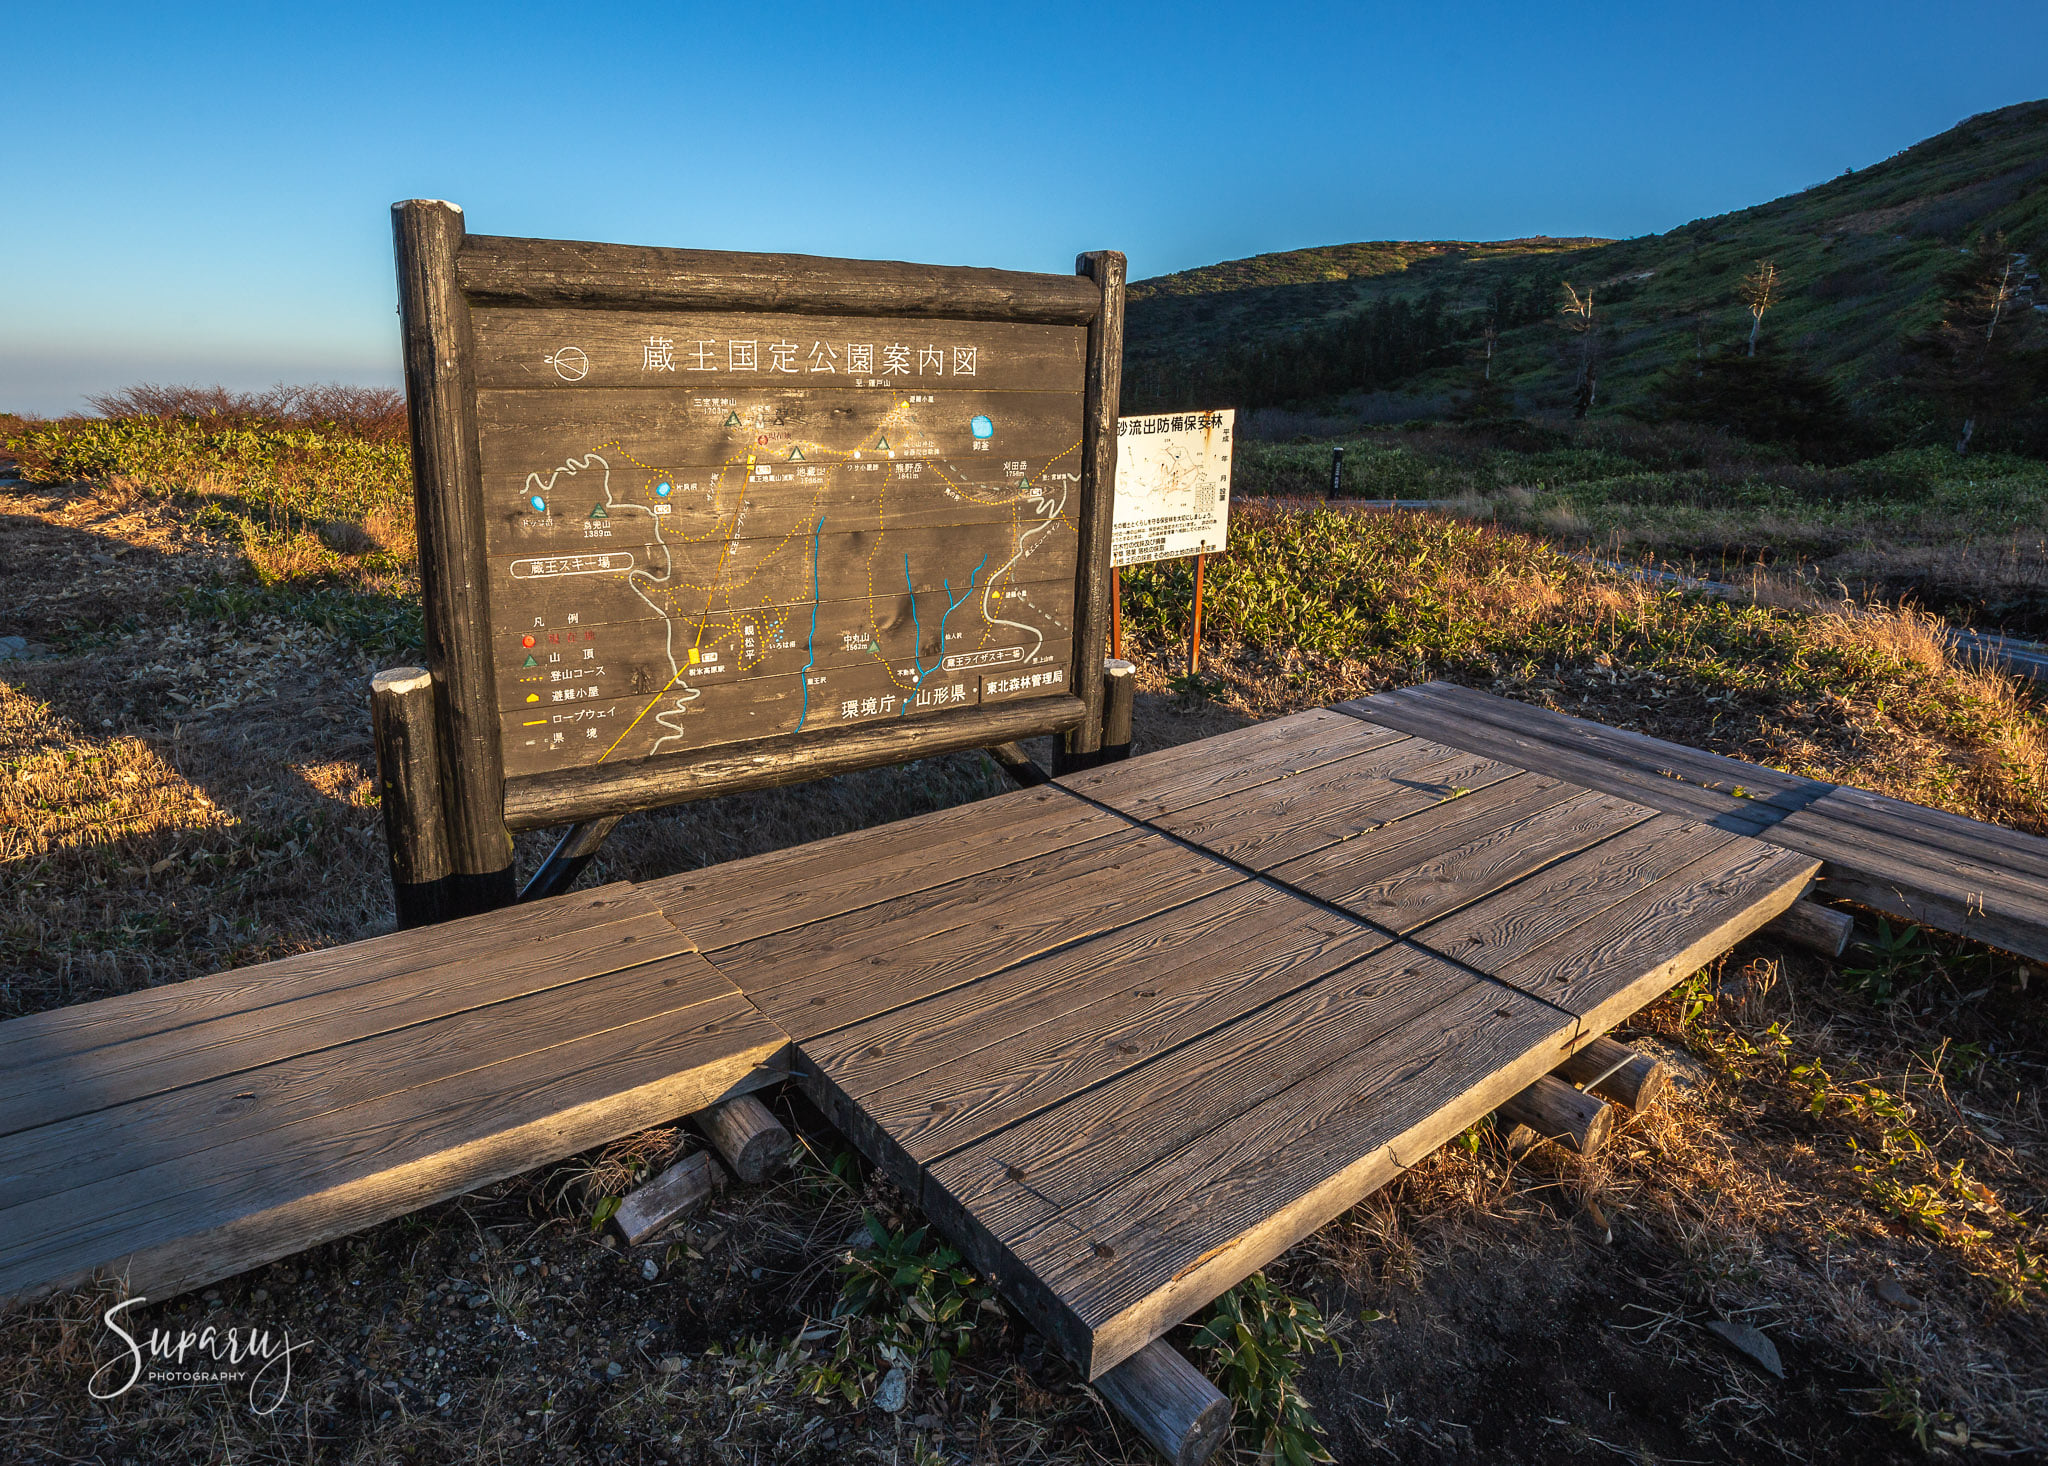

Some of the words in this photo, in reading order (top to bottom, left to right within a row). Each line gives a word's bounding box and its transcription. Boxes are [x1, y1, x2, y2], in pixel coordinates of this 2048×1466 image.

[641, 336, 978, 377] 蔵王国定公園案内図
[796, 467, 826, 477] 地蔵山
[895, 463, 923, 473] 熊野岳
[1003, 460, 1028, 471] 刈田岳
[583, 529, 613, 538] 1389m
[530, 557, 611, 575] 蔵王スキー場
[744, 625, 755, 660] 観松平
[843, 632, 870, 643] 中丸山
[945, 649, 1021, 668] 蔵王ライザスキー場
[550, 665, 606, 682] 登山コース
[986, 670, 1063, 695] 東北森林管理局
[551, 685, 600, 702] 避難小屋
[552, 706, 616, 723] ロープウェイ
